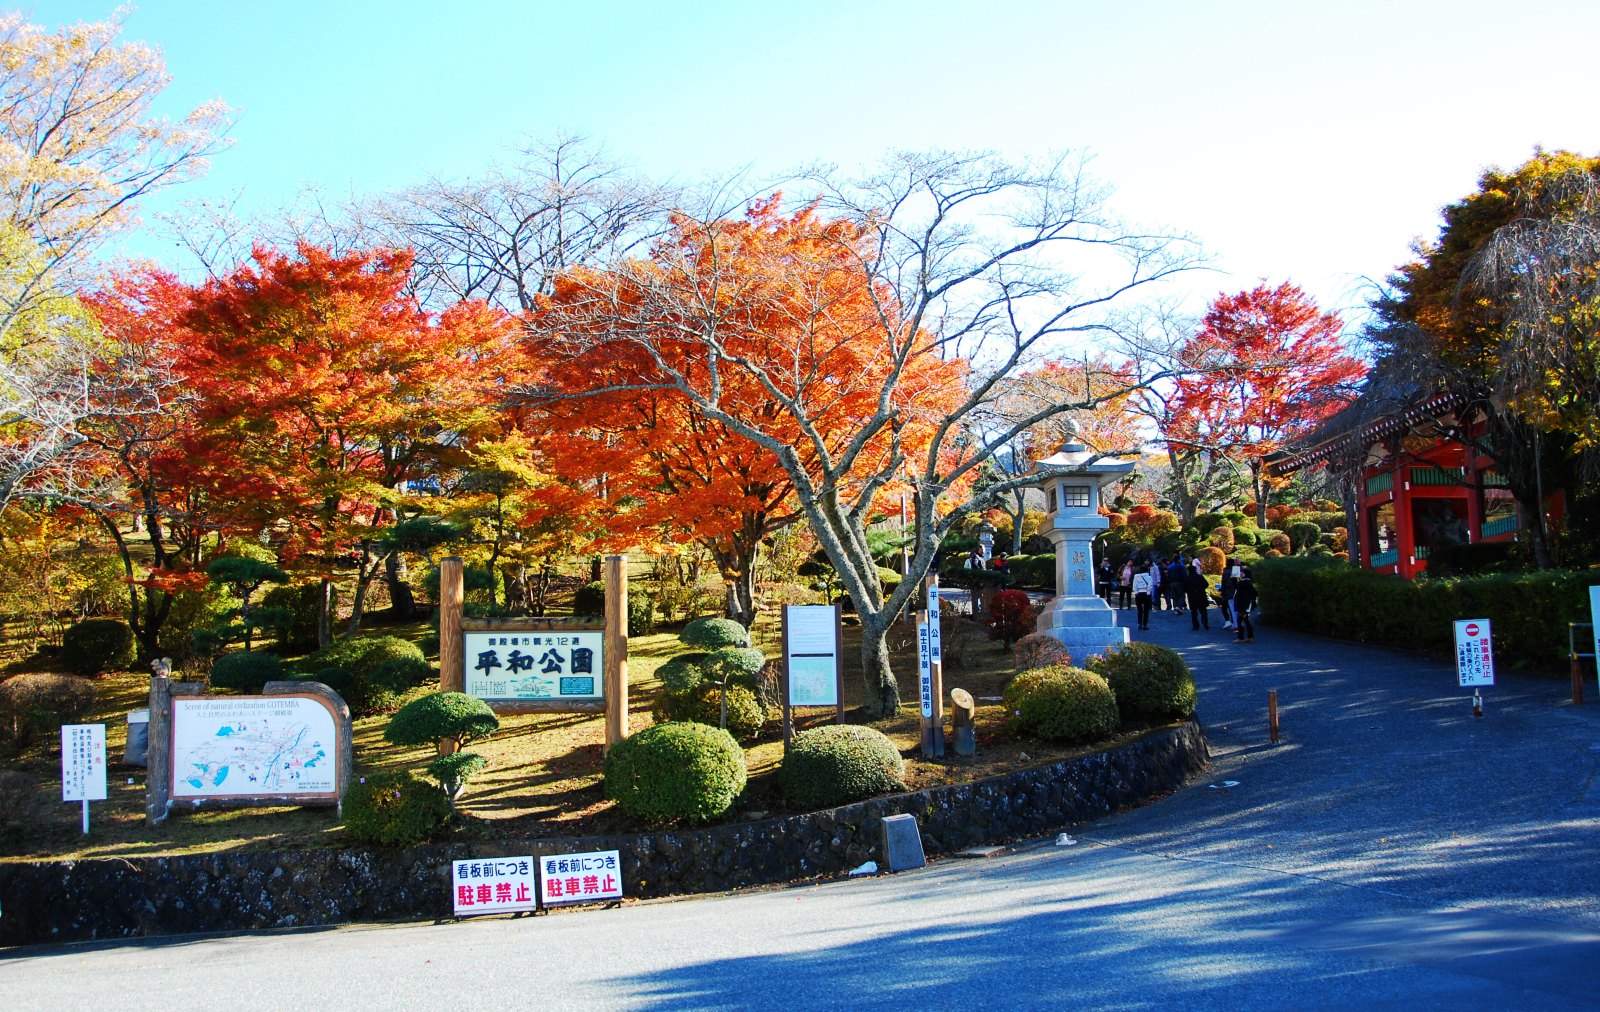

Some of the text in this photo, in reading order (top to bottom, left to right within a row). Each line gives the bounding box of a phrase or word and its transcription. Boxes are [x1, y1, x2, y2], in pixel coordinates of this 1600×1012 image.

[929, 591, 940, 657] 平和公園
[474, 647, 594, 677] 平和公園
[919, 628, 930, 710] 富士見十景 御殿場市
[184, 702, 202, 711] Scent
[203, 702, 210, 710] of
[211, 702, 233, 710] natural
[267, 699, 300, 709] GOTEMBA
[457, 860, 530, 879] 看板前につき
[545, 855, 616, 875] 看板前につき
[457, 882, 532, 906] 駐車禁止
[547, 874, 618, 898] 駐車禁止
